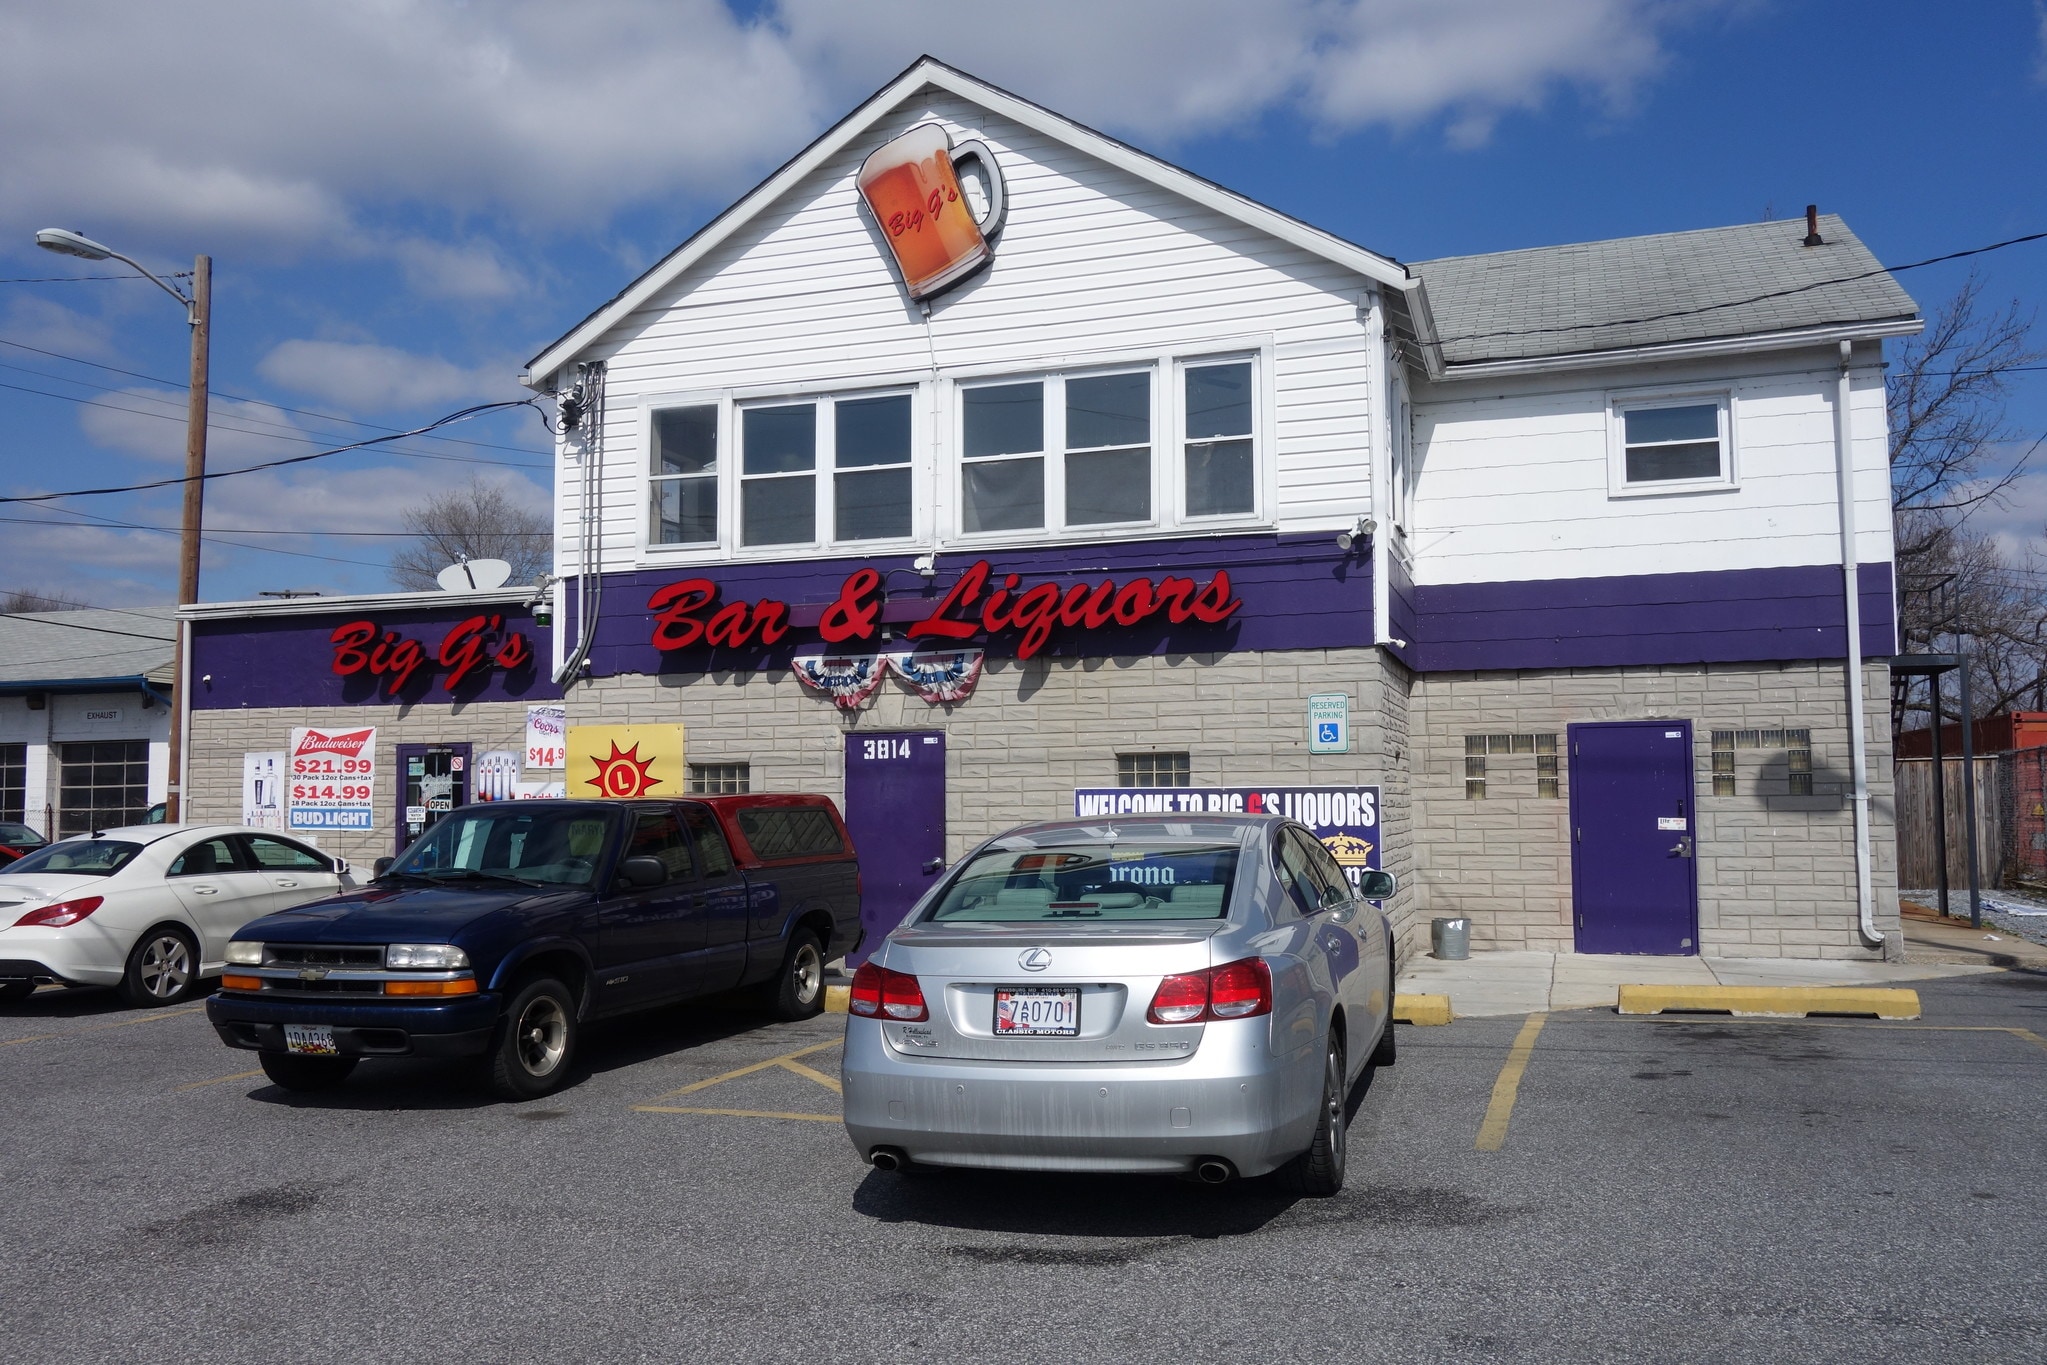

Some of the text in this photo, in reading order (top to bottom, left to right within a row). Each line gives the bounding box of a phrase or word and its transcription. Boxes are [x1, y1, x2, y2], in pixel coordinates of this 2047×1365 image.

[888, 184, 958, 237] Big G's
[647, 559, 1242, 661] Bar & Liquors
[330, 614, 529, 695] Big G's
[1311, 701, 1345, 709] RESERVED
[87, 711, 117, 719] EXHAUST
[1313, 711, 1343, 719] PARKING
[533, 718, 560, 733] Coors
[300, 735, 367, 751] Budweiser
[863, 739, 911, 760] 3814
[529, 747, 565, 767] $14.9
[294, 758, 372, 774] $21.99
[293, 784, 371, 800] $14.99
[430, 801, 450, 809] OPEN
[1078, 793, 1174, 816] WELCOME
[1177, 793, 1204, 812] TO
[1208, 793, 1243, 813] BIG
[1285, 792, 1376, 829] LIQUORS
[292, 811, 369, 825] BUD LIGHT
